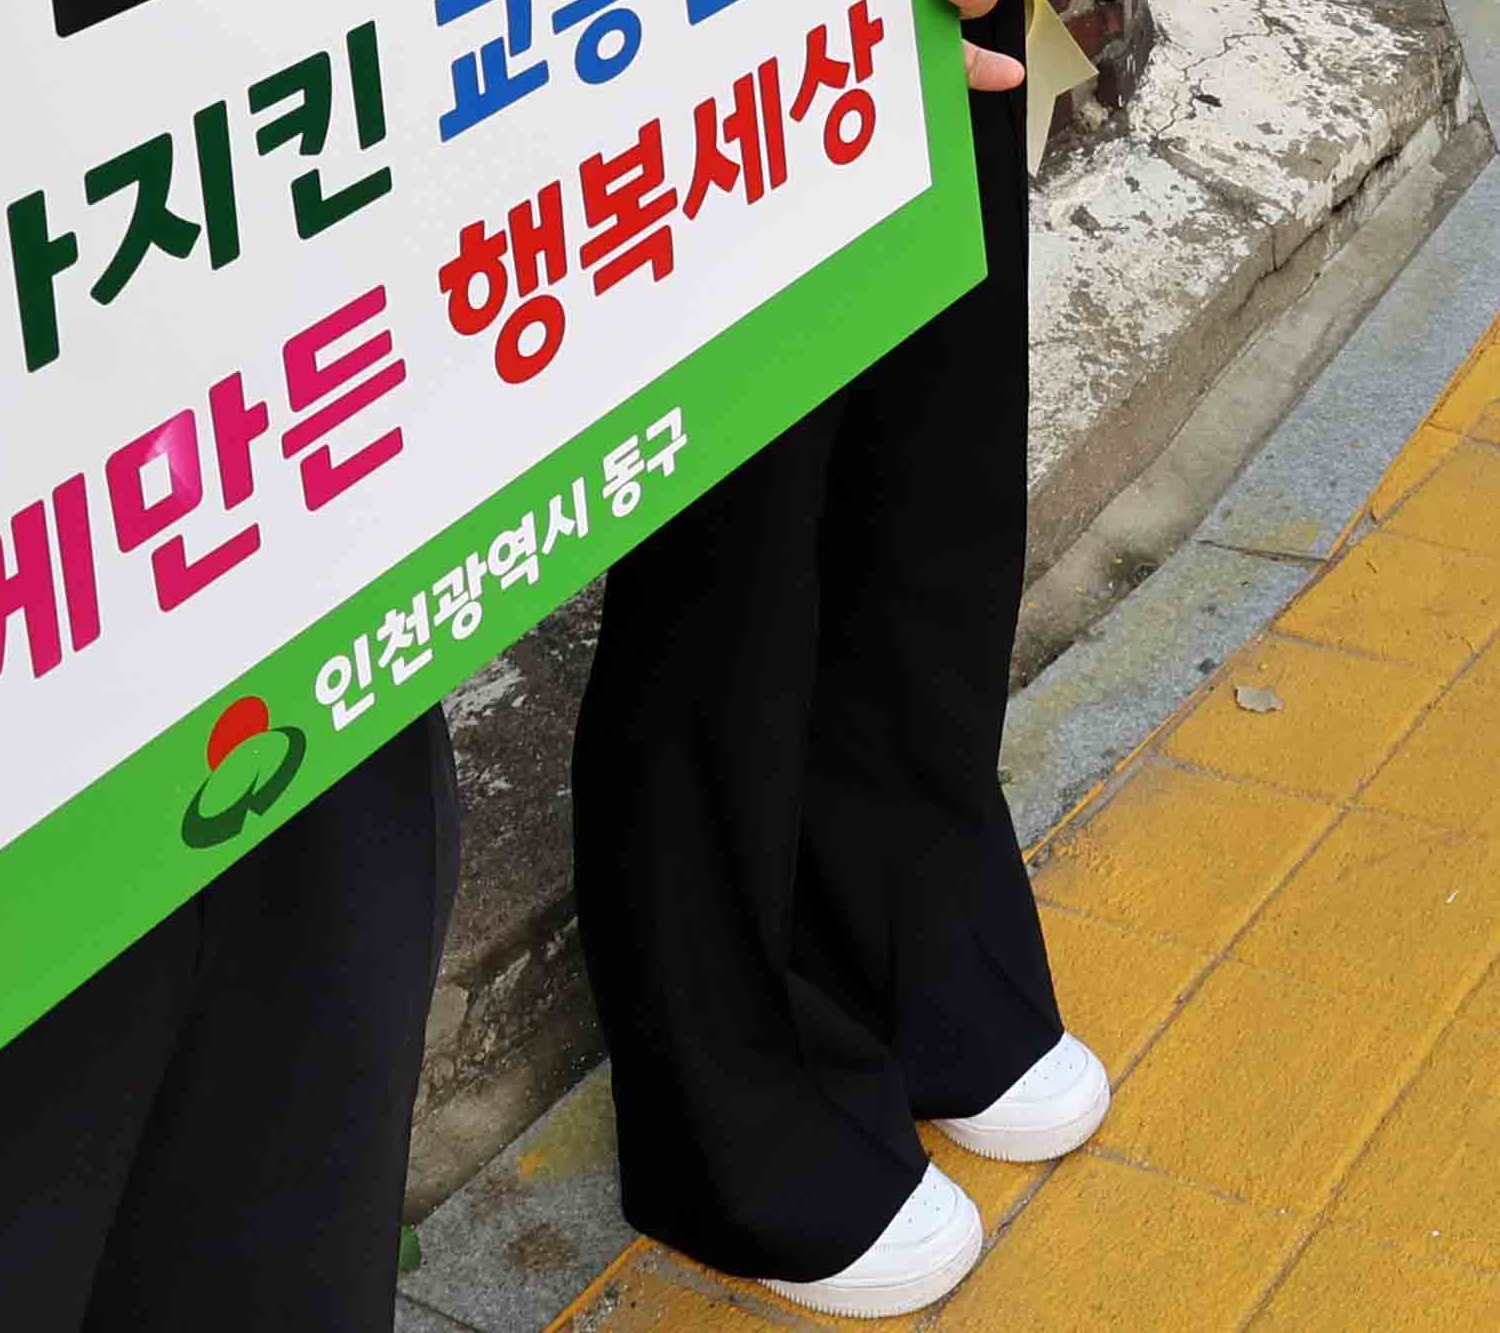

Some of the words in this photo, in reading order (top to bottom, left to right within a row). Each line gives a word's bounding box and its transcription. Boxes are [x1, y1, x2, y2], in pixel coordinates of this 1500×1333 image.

[440, 0, 884, 385] 행복세상
[313, 490, 592, 731] 인천광역시
[599, 406, 688, 519] 동구
